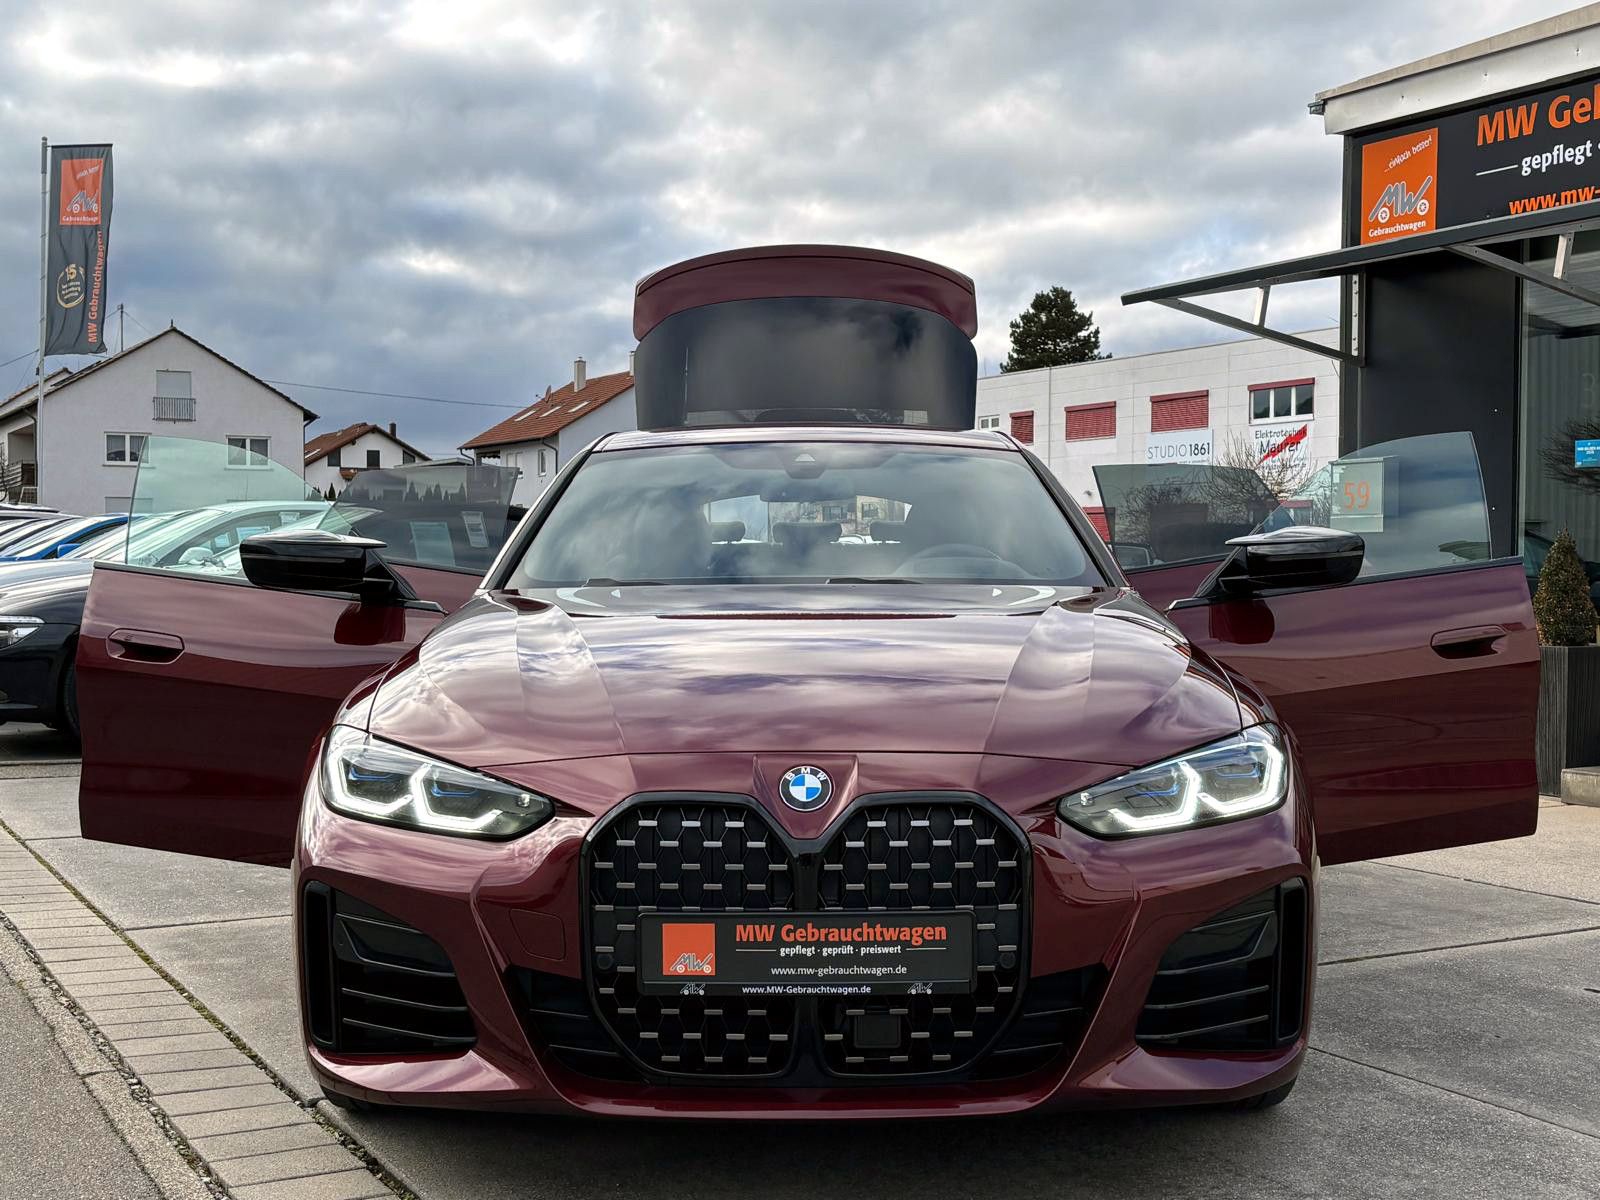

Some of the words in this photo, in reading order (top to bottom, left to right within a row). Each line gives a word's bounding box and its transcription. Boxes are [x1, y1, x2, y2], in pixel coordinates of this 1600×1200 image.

[1477, 102, 1538, 146] MW
[1521, 140, 1593, 176] gepflegt
[1368, 175, 1433, 222] MW
[1368, 220, 1427, 238] Gebrauchtwagen
[65, 264, 77, 281] 15
[88, 231, 104, 320] Gebrauchtwagen
[88, 322, 98, 343] MW
[1255, 425, 1307, 440] Elektrotechnik
[1147, 444, 1187, 460] STUDIO
[1189, 442, 1210, 457] 1861
[1260, 439, 1301, 456] Maurer
[1344, 480, 1371, 511] 59
[736, 924, 776, 942] MW
[781, 922, 947, 946] Gebrauchtwagen
[780, 945, 816, 957] gepflegt
[822, 945, 854, 957] geprüft
[860, 944, 902, 957] preiswert
[669, 952, 714, 974] MW
[771, 965, 908, 977] www.mw-gebrauchtwagen.de
[742, 985, 872, 996] www.MW-Gebrauchtwagen.de
